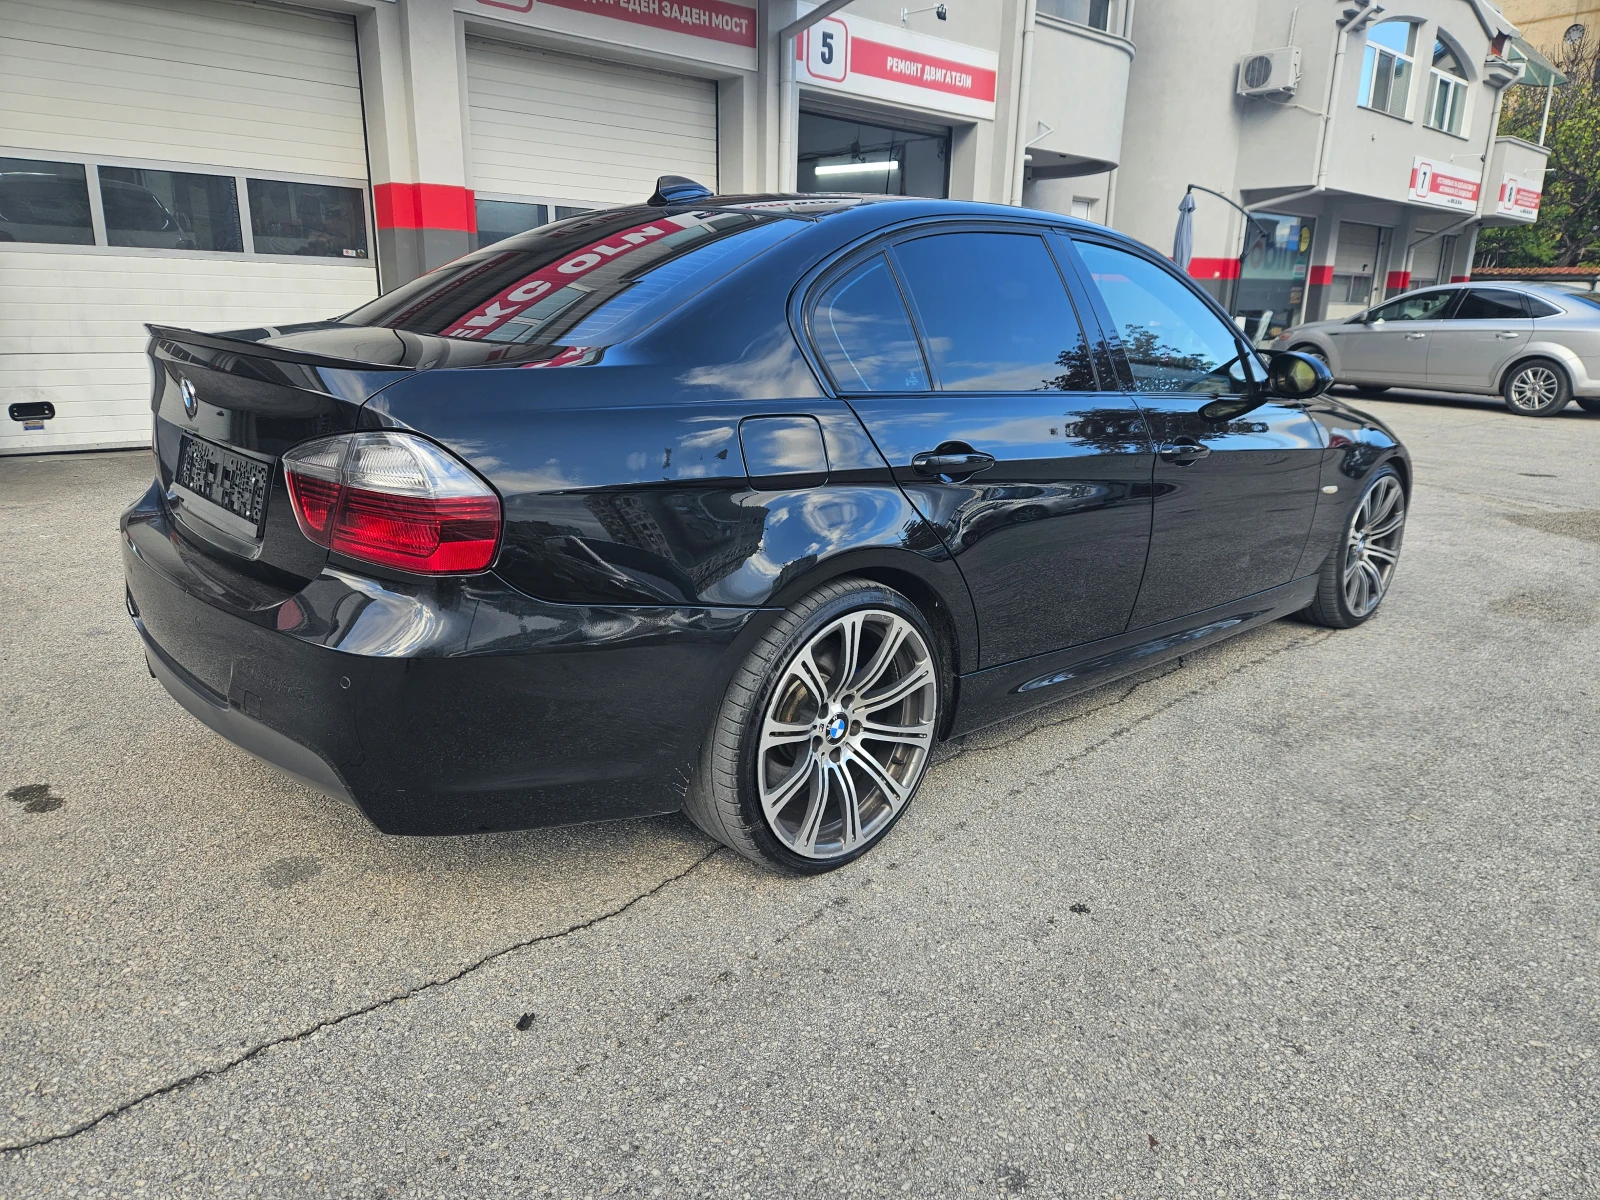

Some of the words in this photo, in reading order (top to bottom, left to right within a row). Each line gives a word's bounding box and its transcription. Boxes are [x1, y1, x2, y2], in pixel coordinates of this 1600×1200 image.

[599, 0, 659, 15] ЕДЕН
[661, 1, 709, 26] ЗАДЕН
[711, 12, 749, 34] МОСТ
[820, 31, 834, 64] 5
[887, 56, 923, 74] РЕМОНТ
[923, 64, 972, 89] ДВИГАТЕЛИ
[1421, 171, 1428, 189] 7
[1508, 186, 1514, 202] 8
